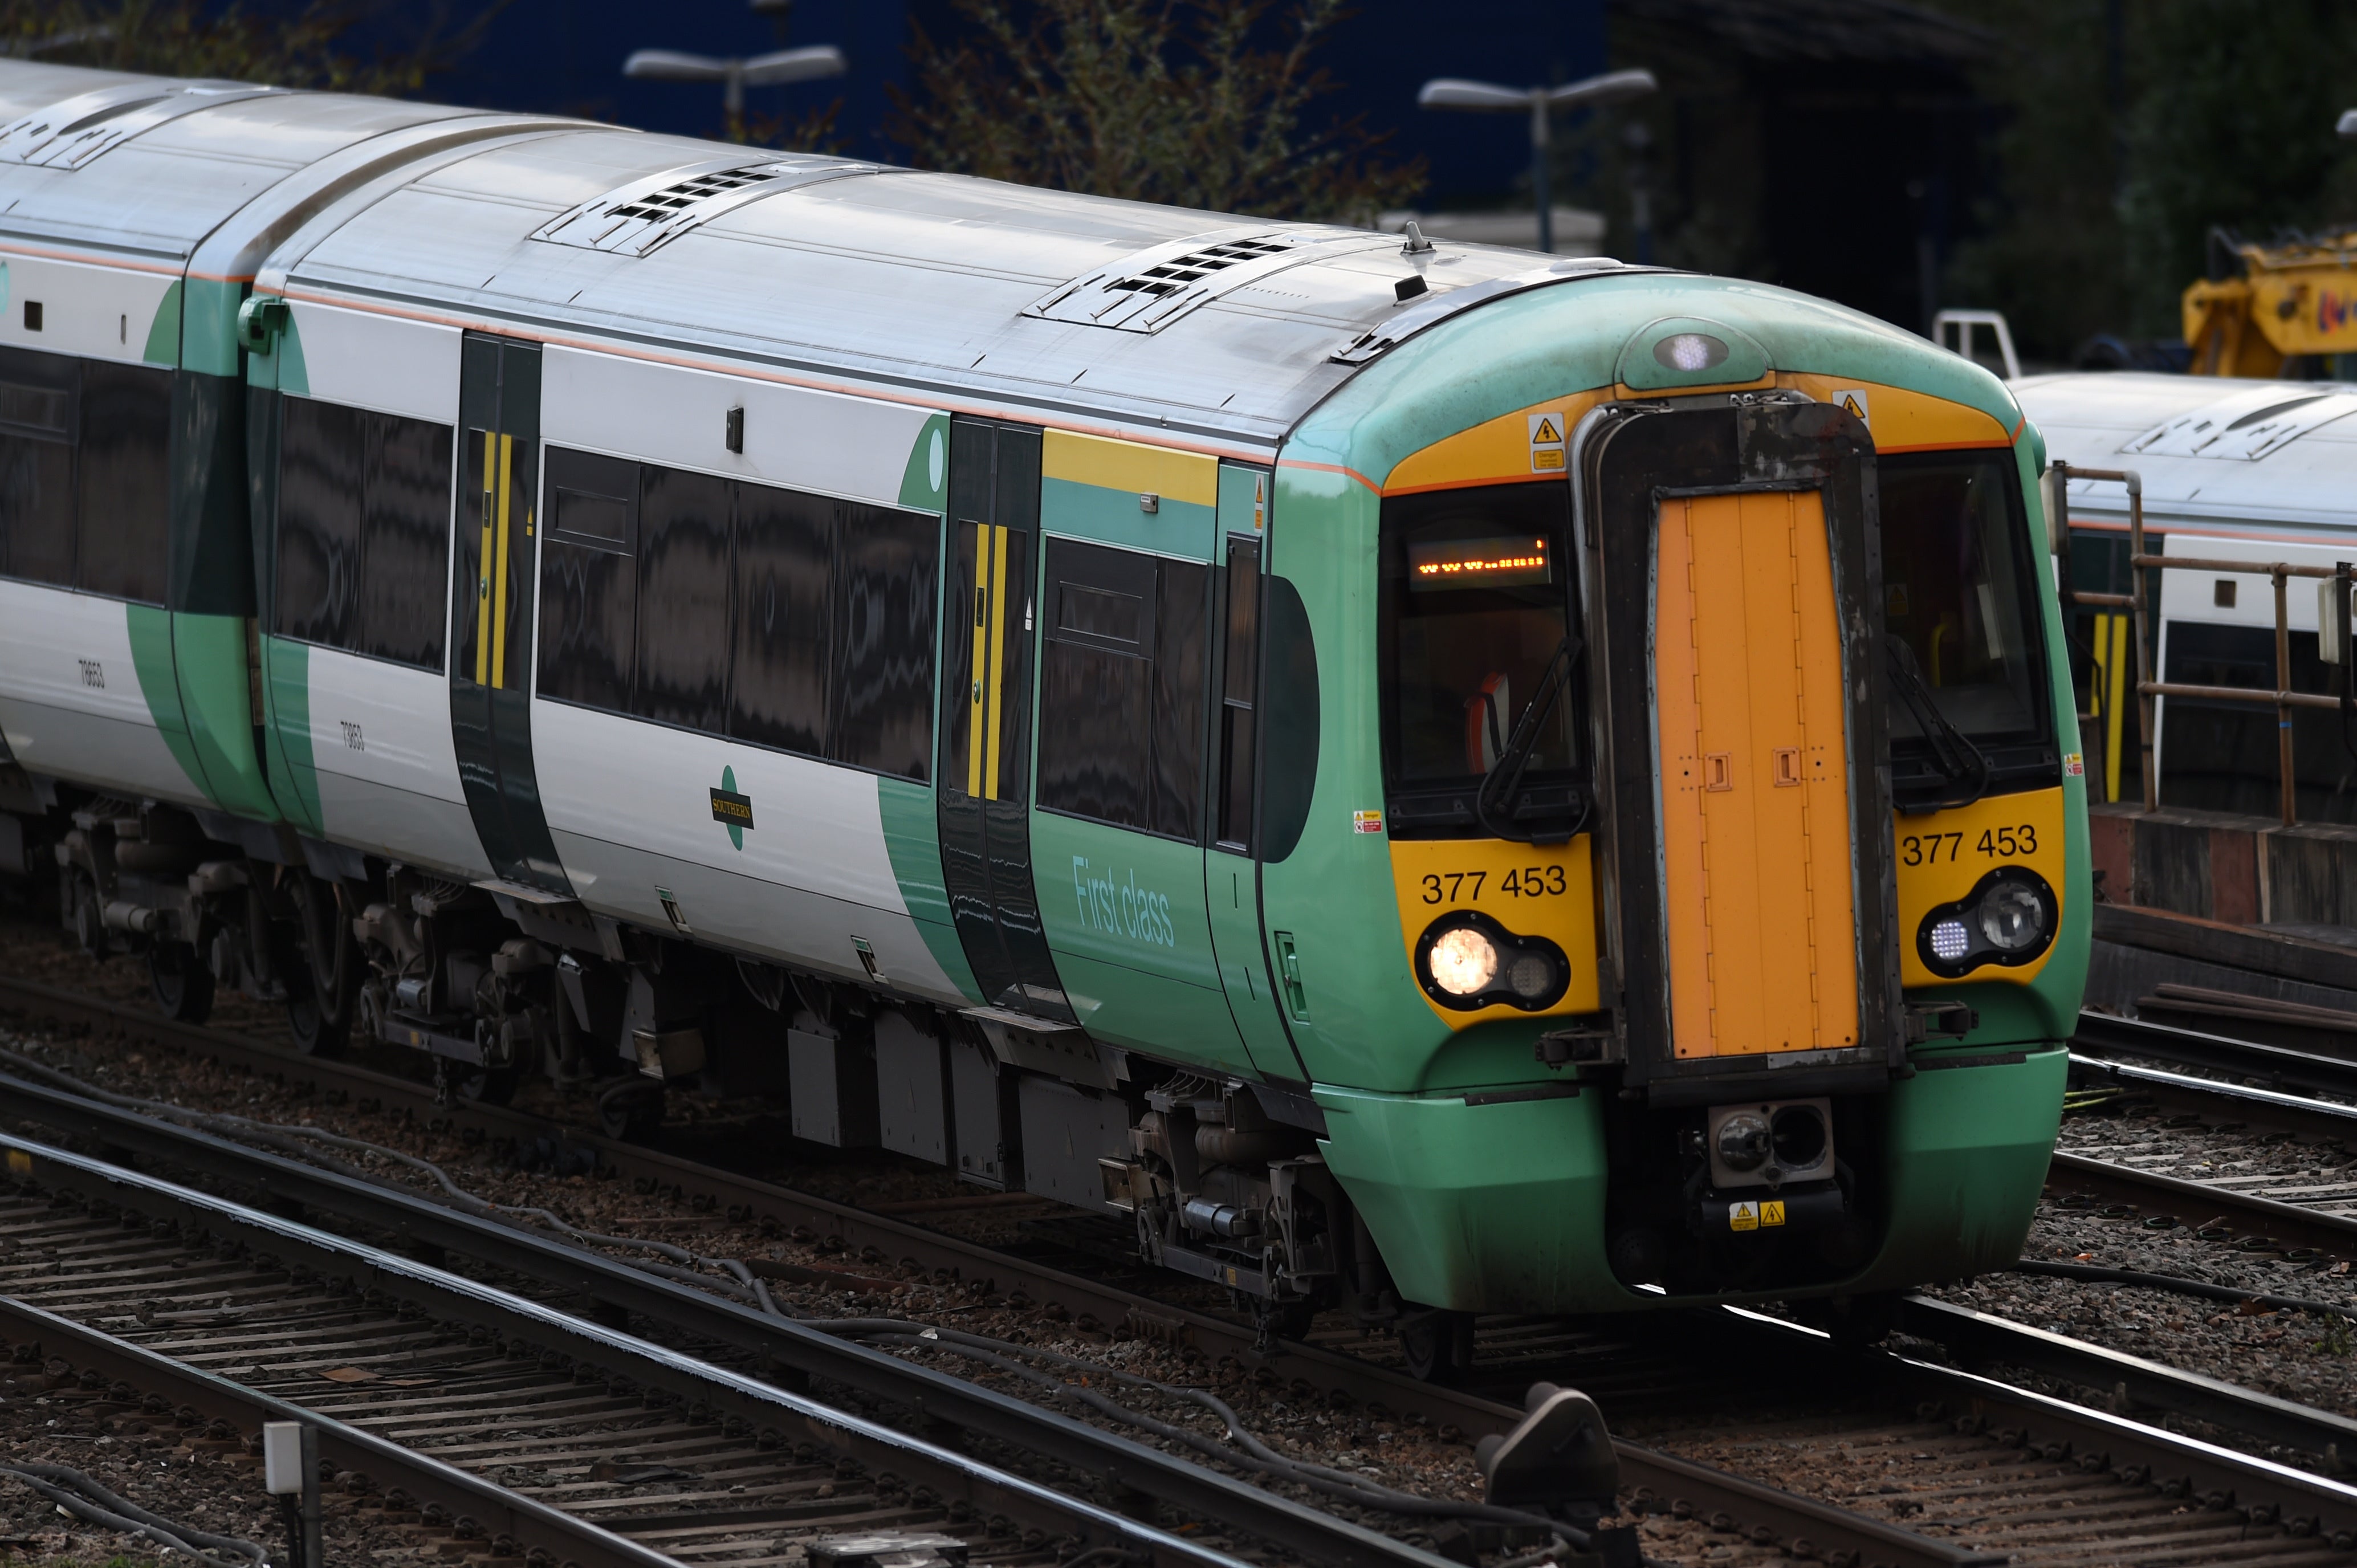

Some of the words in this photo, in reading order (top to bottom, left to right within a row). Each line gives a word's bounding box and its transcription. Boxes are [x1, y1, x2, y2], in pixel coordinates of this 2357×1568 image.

[79, 659, 105, 689] 78653
[340, 721, 365, 752] 73853
[713, 798, 751, 819] SOUTHERN
[1902, 832, 1964, 866] 377
[1976, 824, 2038, 858] 453
[1073, 856, 1122, 935] First
[1122, 868, 1174, 947] class
[1422, 871, 1487, 905] 377
[1501, 865, 1567, 898] 453
